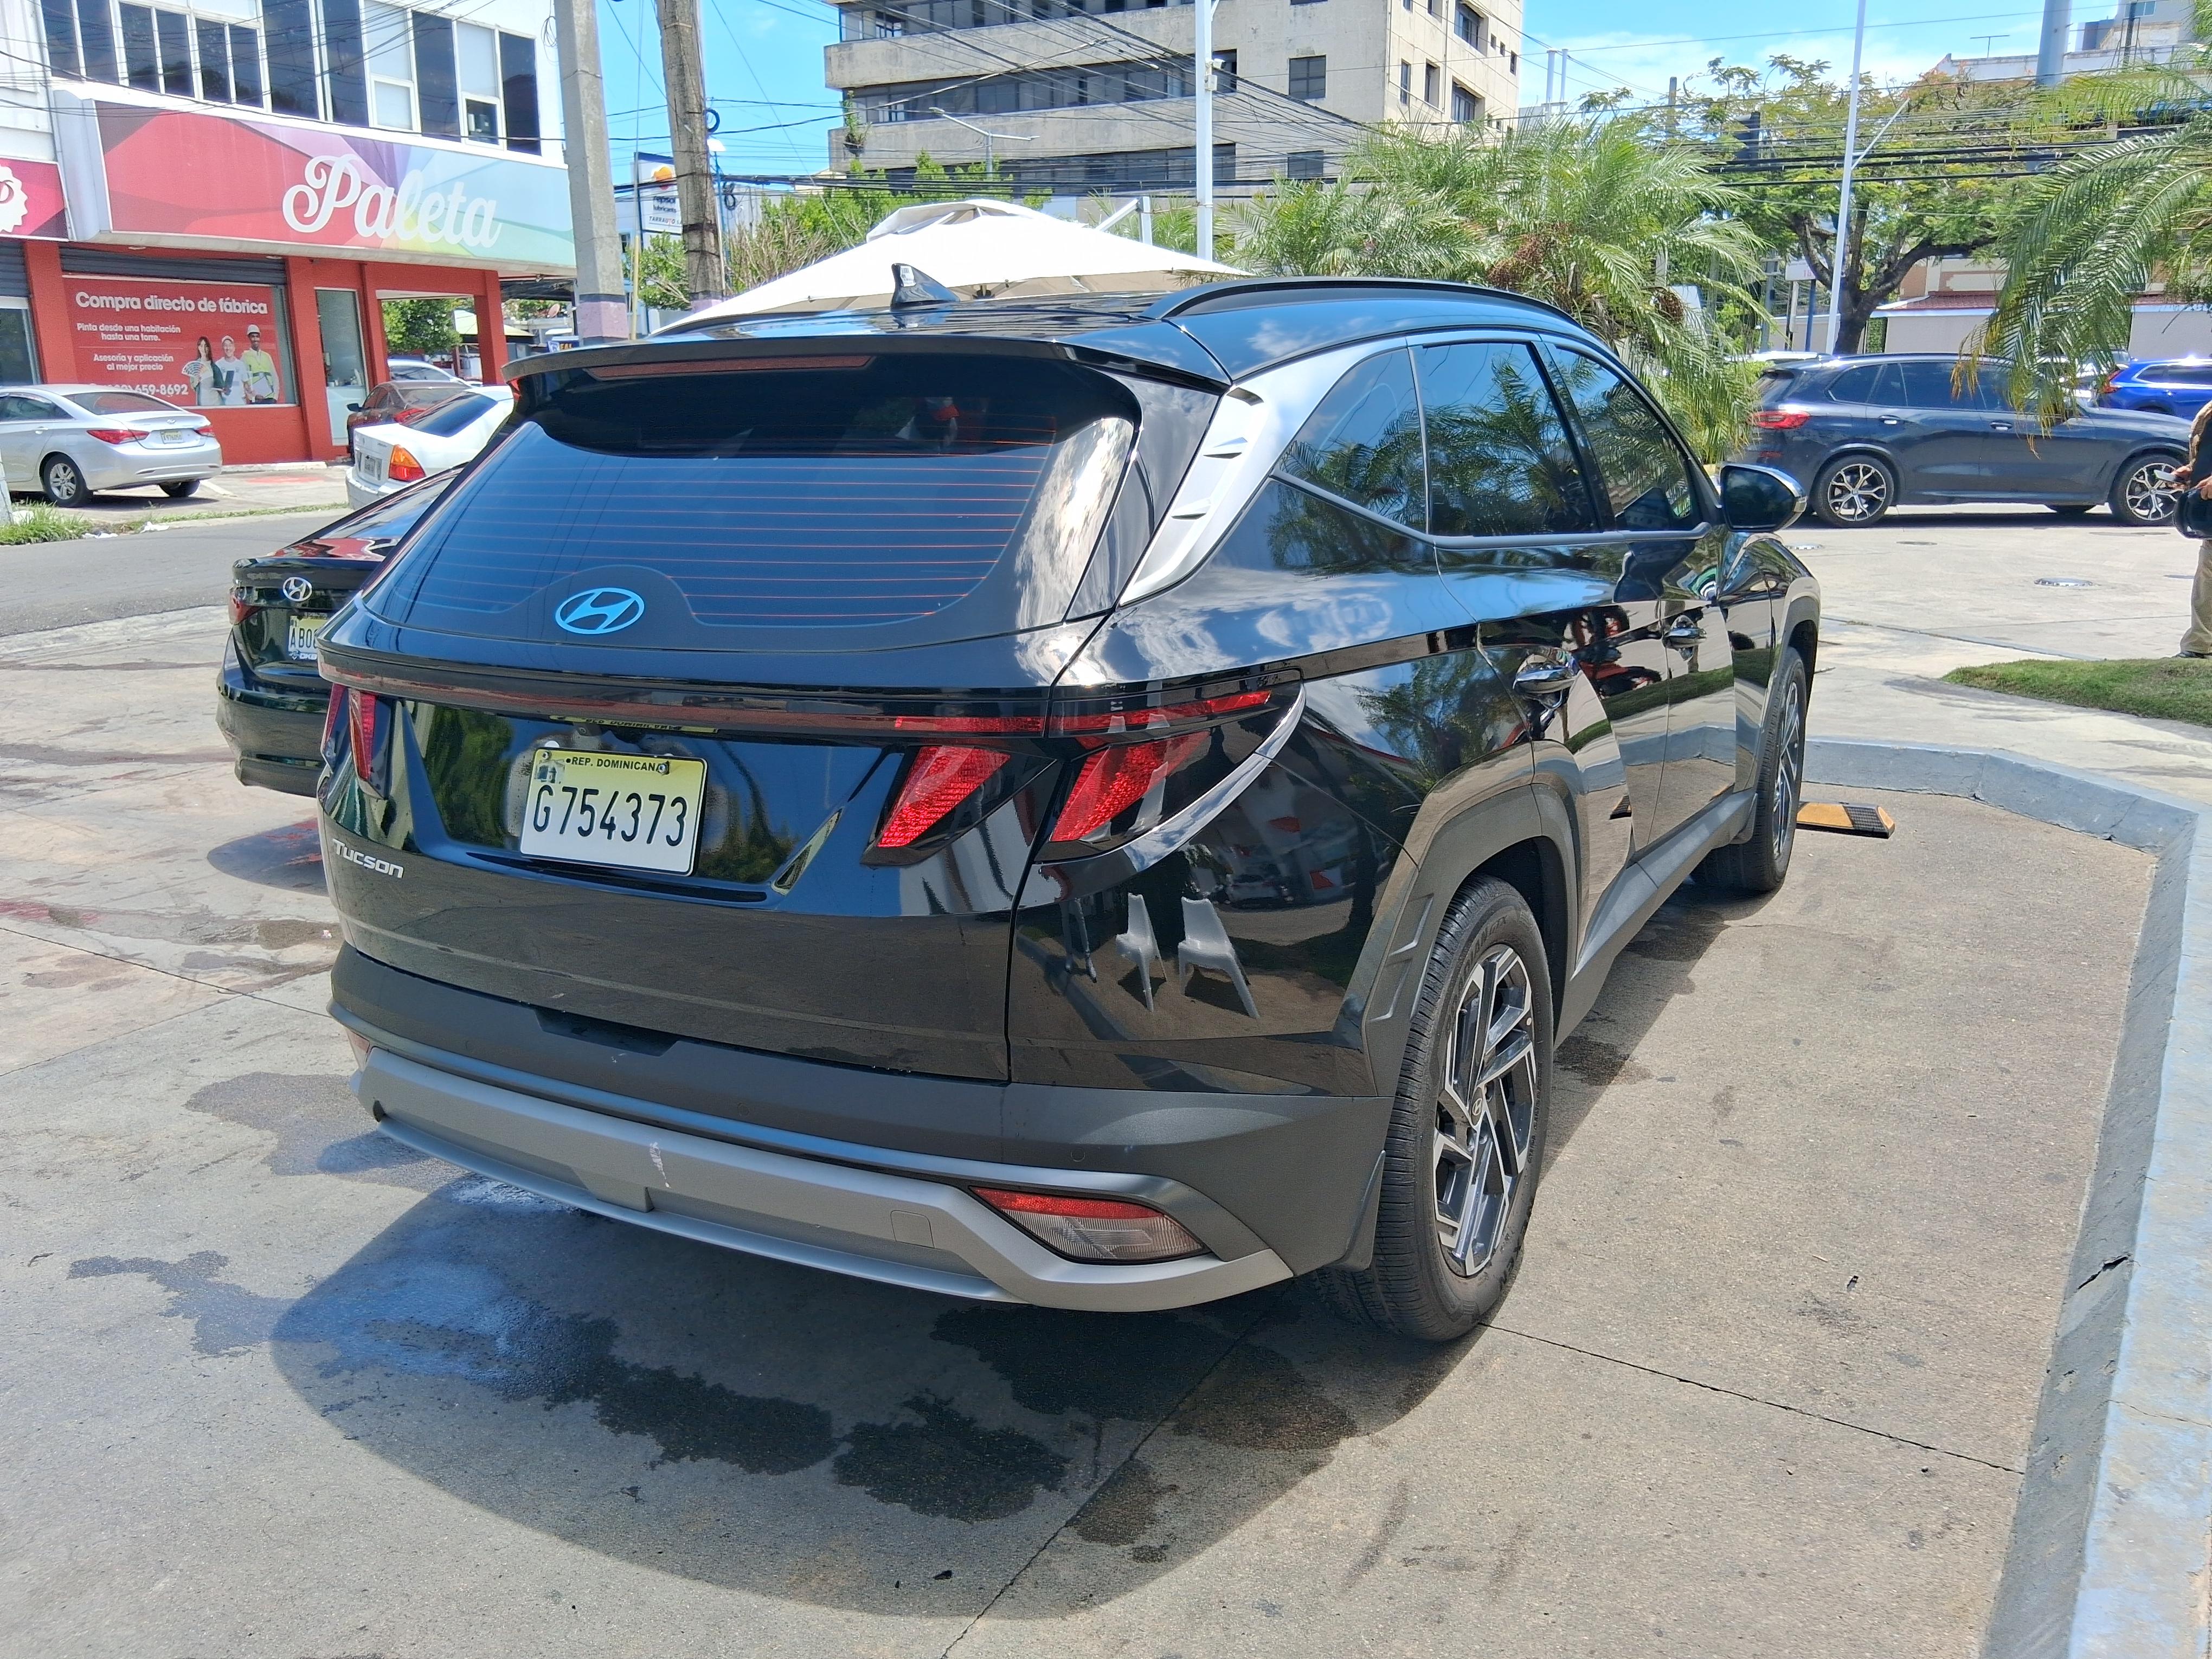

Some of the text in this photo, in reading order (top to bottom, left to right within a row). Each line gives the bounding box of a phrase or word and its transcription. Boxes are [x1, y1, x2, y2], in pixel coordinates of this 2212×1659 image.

[282, 154, 503, 248] Paleta
[76, 292, 268, 314] Compra directo de fábrica
[76, 323, 98, 331] Pinta
[99, 324, 123, 332] desde
[140, 325, 181, 333] habitación
[140, 333, 161, 342] torre.
[93, 353, 173, 363] Asesoría y aplicación
[106, 363, 164, 372] al mejor precio
[136, 384, 189, 395] 659-8692
[571, 757, 593, 767] REP.
[533, 785, 688, 847] G754373
